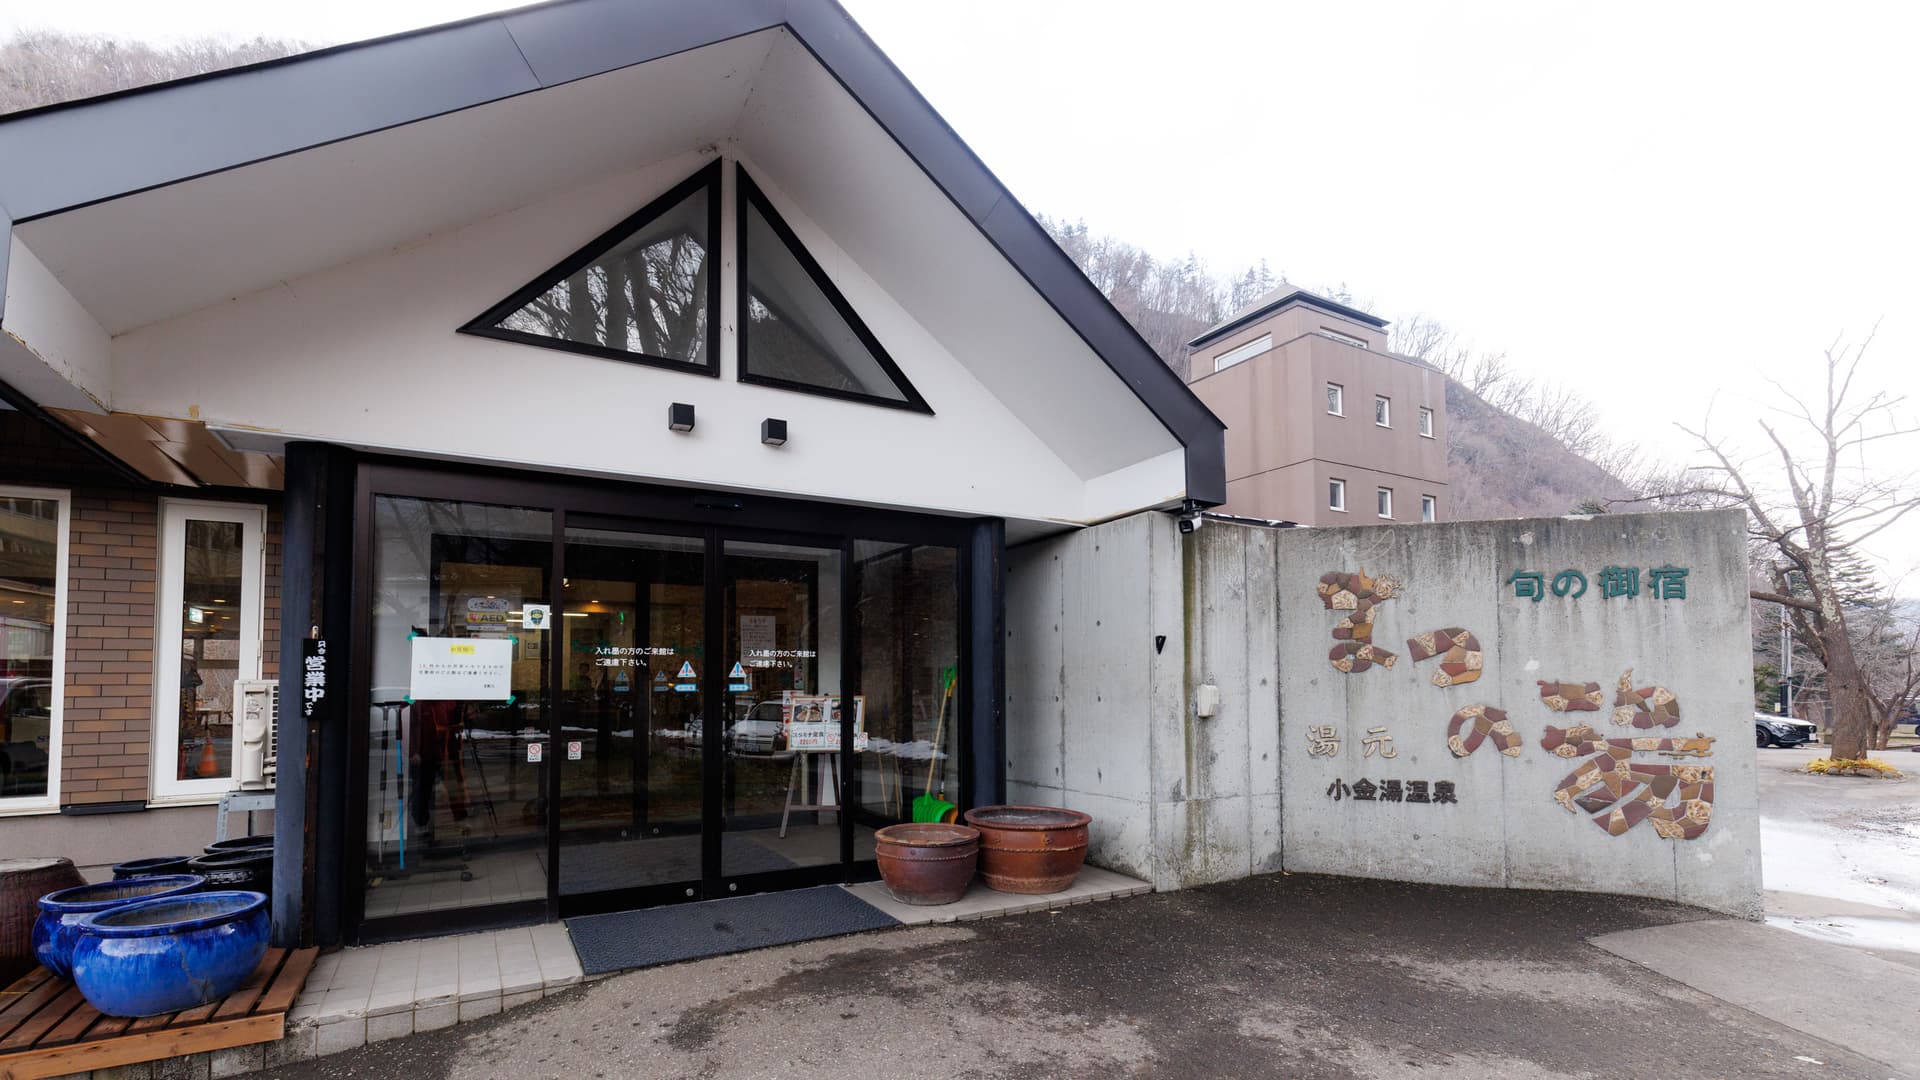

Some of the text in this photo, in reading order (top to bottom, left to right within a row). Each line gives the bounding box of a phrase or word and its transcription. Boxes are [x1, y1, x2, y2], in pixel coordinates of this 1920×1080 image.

[1507, 564, 1690, 602] 旬の御宿
[480, 613, 504, 622] AED
[1305, 725, 1398, 759] 湯元
[1326, 777, 1458, 804] 小金湯温泉
